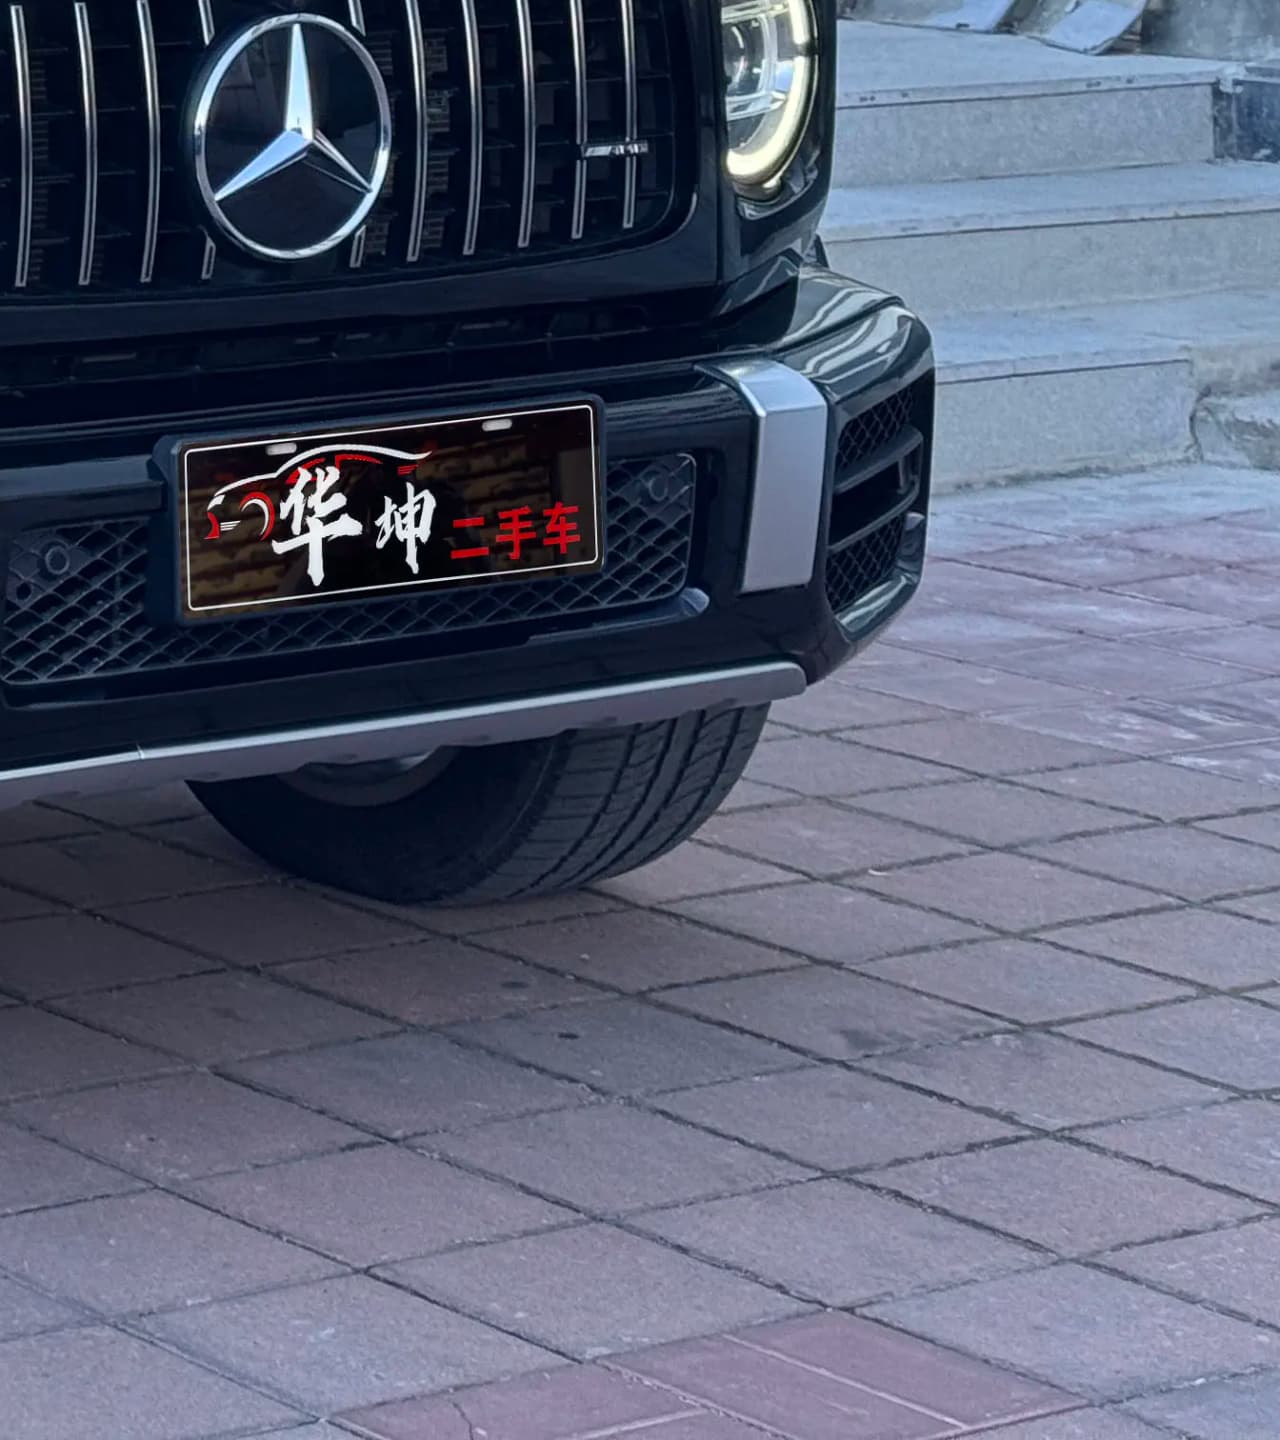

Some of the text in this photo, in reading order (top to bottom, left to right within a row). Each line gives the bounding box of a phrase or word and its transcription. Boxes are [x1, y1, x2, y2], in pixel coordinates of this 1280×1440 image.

[271, 464, 582, 587] 华坤 二手车
